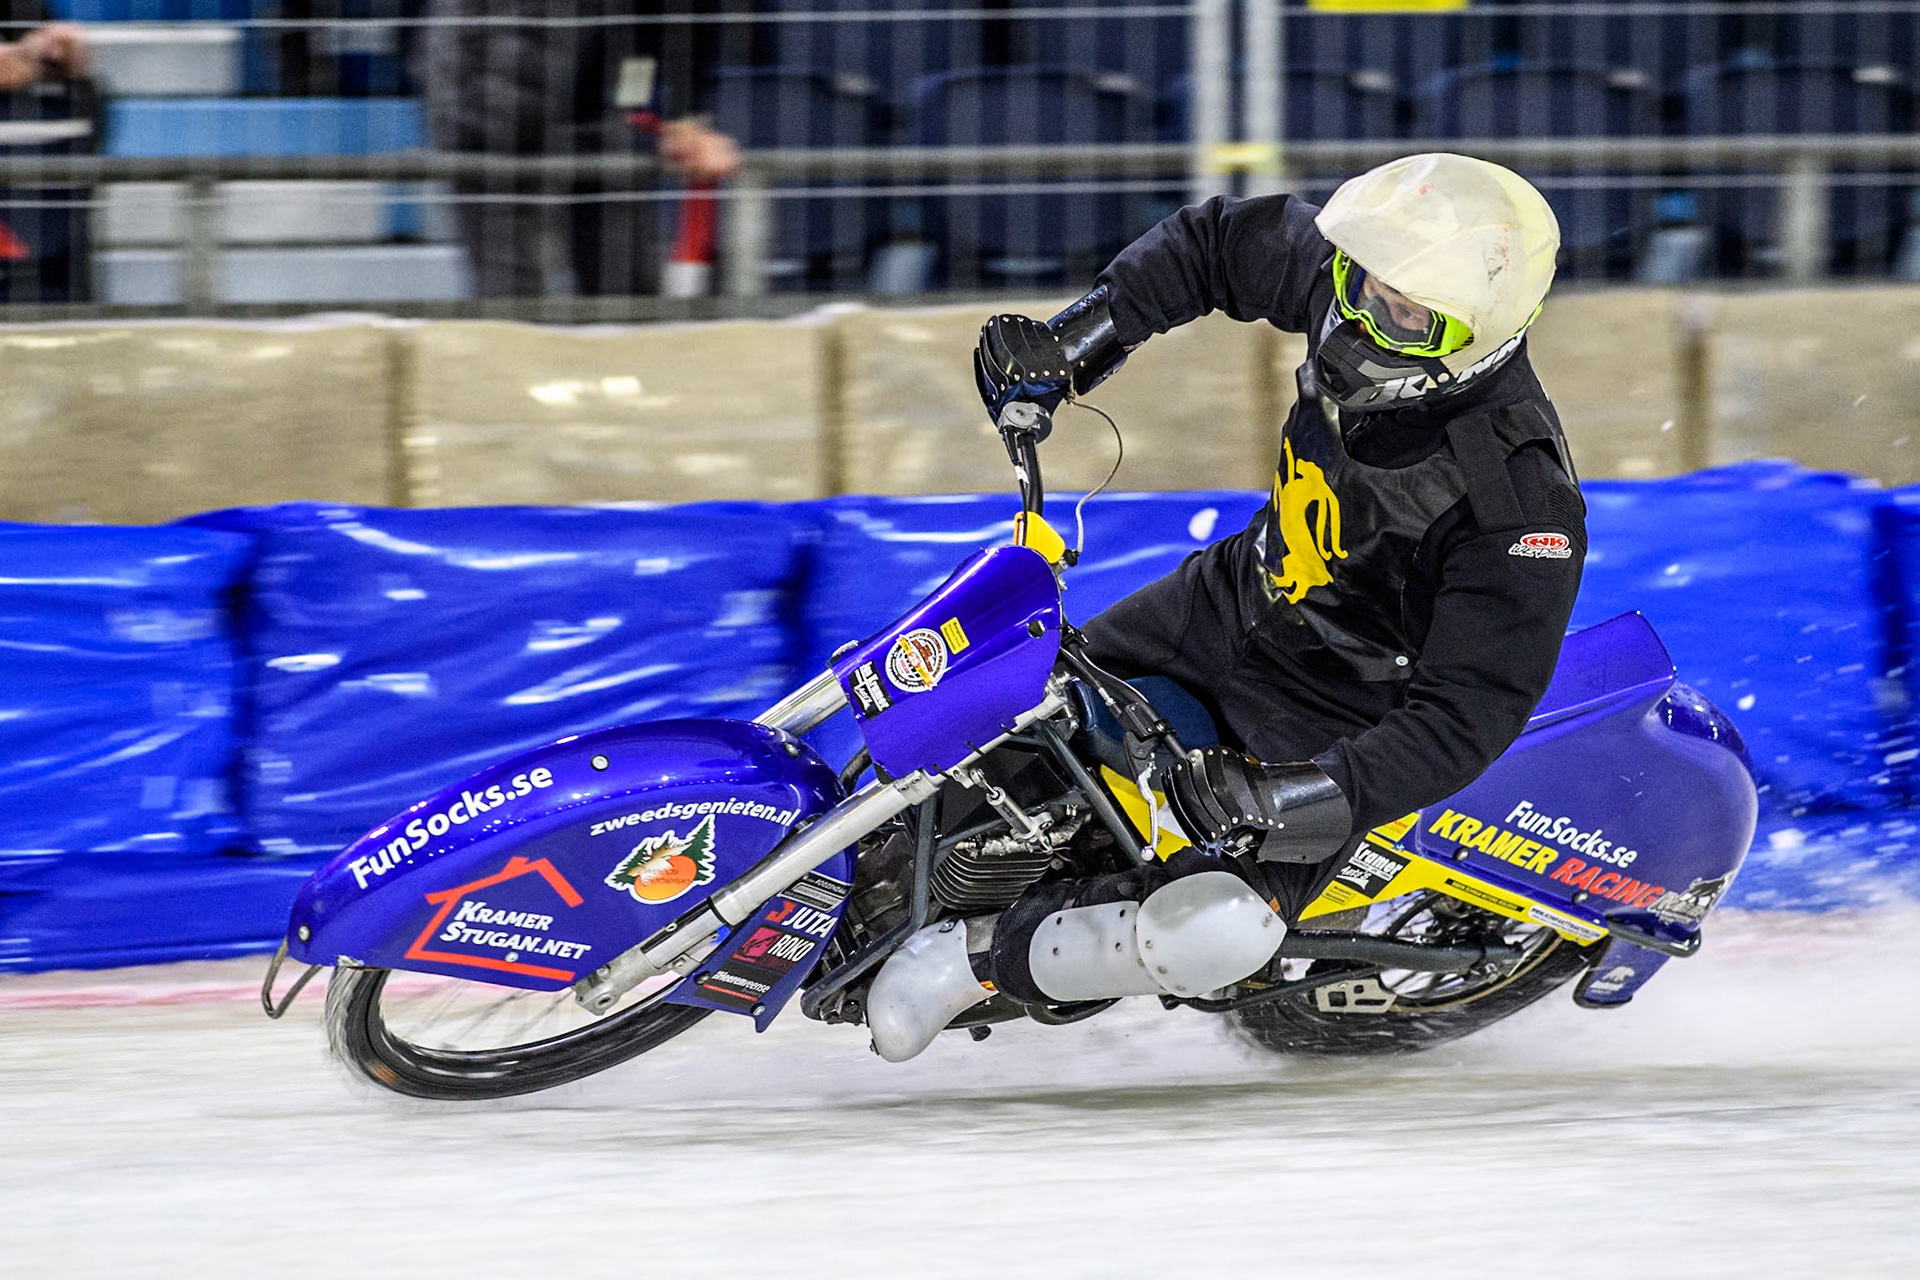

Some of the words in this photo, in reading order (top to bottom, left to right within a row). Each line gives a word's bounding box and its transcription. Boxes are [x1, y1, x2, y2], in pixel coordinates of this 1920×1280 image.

[867, 673, 890, 710] Kramer
[350, 767, 554, 890] FunSocks.se
[590, 797, 801, 836] zweedsgenieten.nl
[1504, 800, 1638, 868] FunSocks.se
[1354, 841, 1404, 875] Kramer
[1428, 808, 1559, 875] KRAMER
[1550, 857, 1665, 908] RACING
[454, 900, 554, 931] KRAMER
[781, 907, 838, 938] JUTA
[439, 921, 592, 960] STUGAN.NET
[767, 934, 816, 962] ROKO
